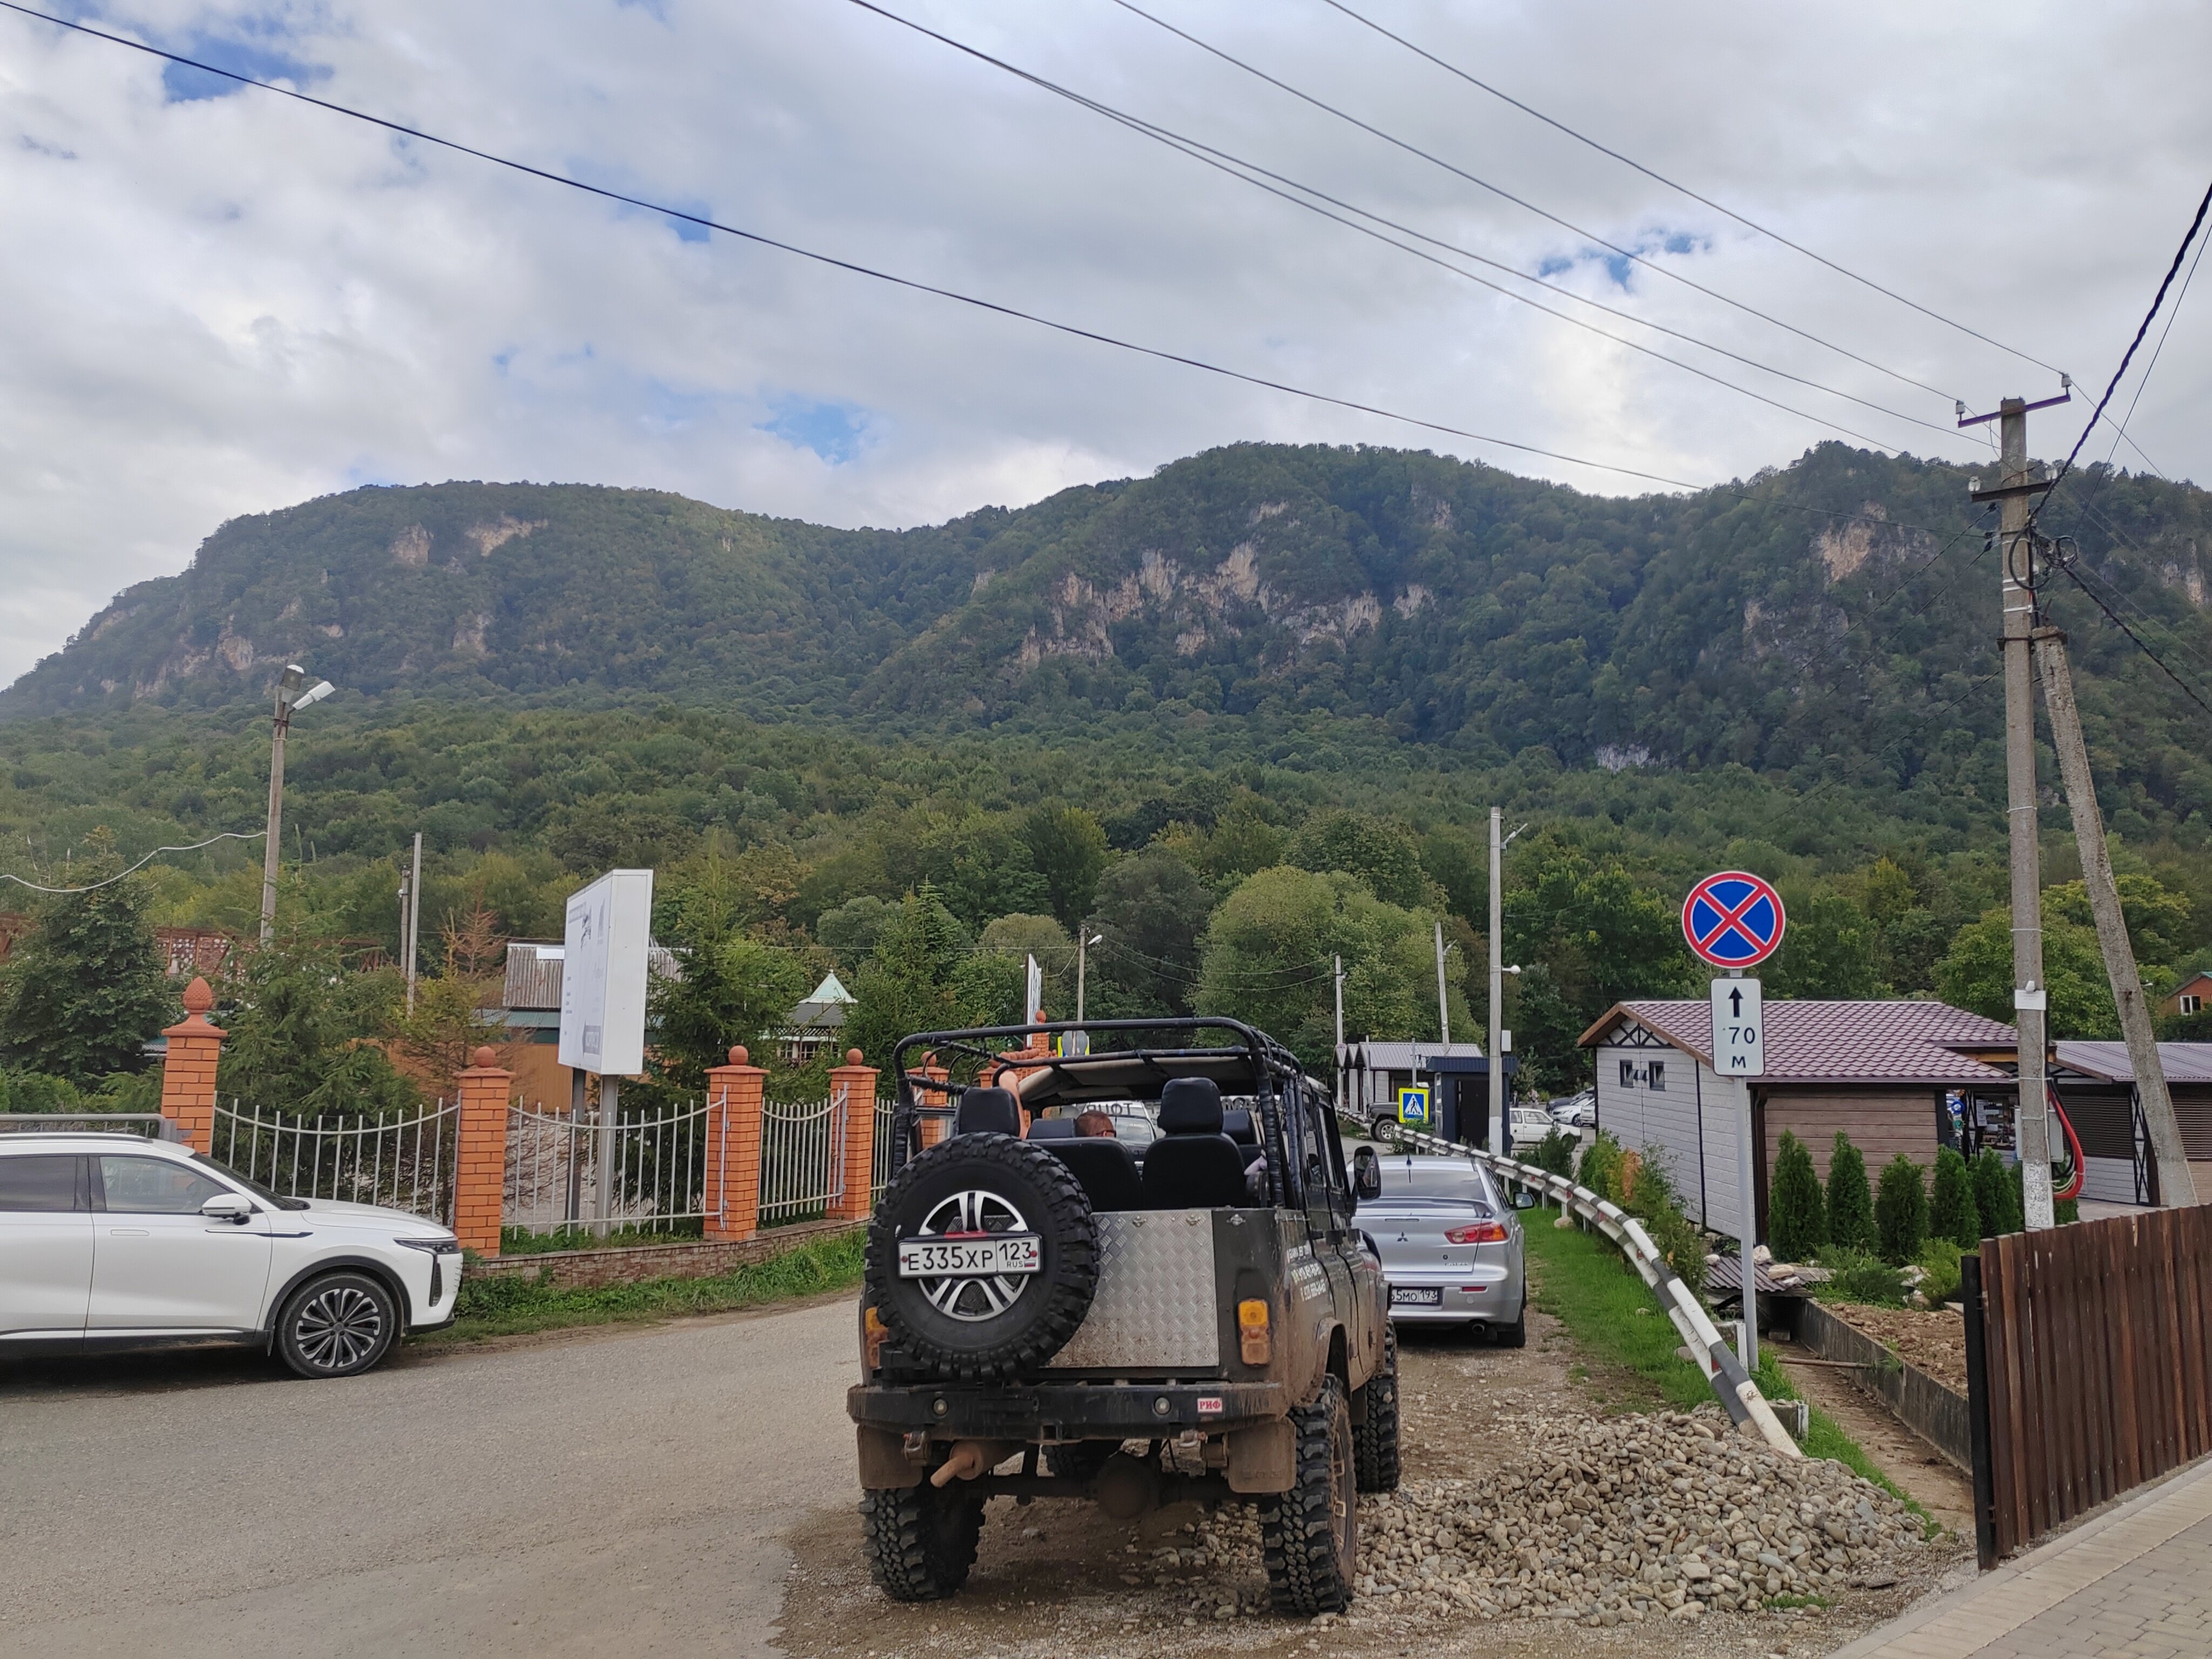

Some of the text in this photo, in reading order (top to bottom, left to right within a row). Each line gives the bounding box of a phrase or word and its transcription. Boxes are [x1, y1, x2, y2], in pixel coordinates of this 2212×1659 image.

[1729, 1027, 1755, 1044] 70
[999, 1242, 1031, 1260] 123
[1199, 1400, 1220, 1410] РИФ
